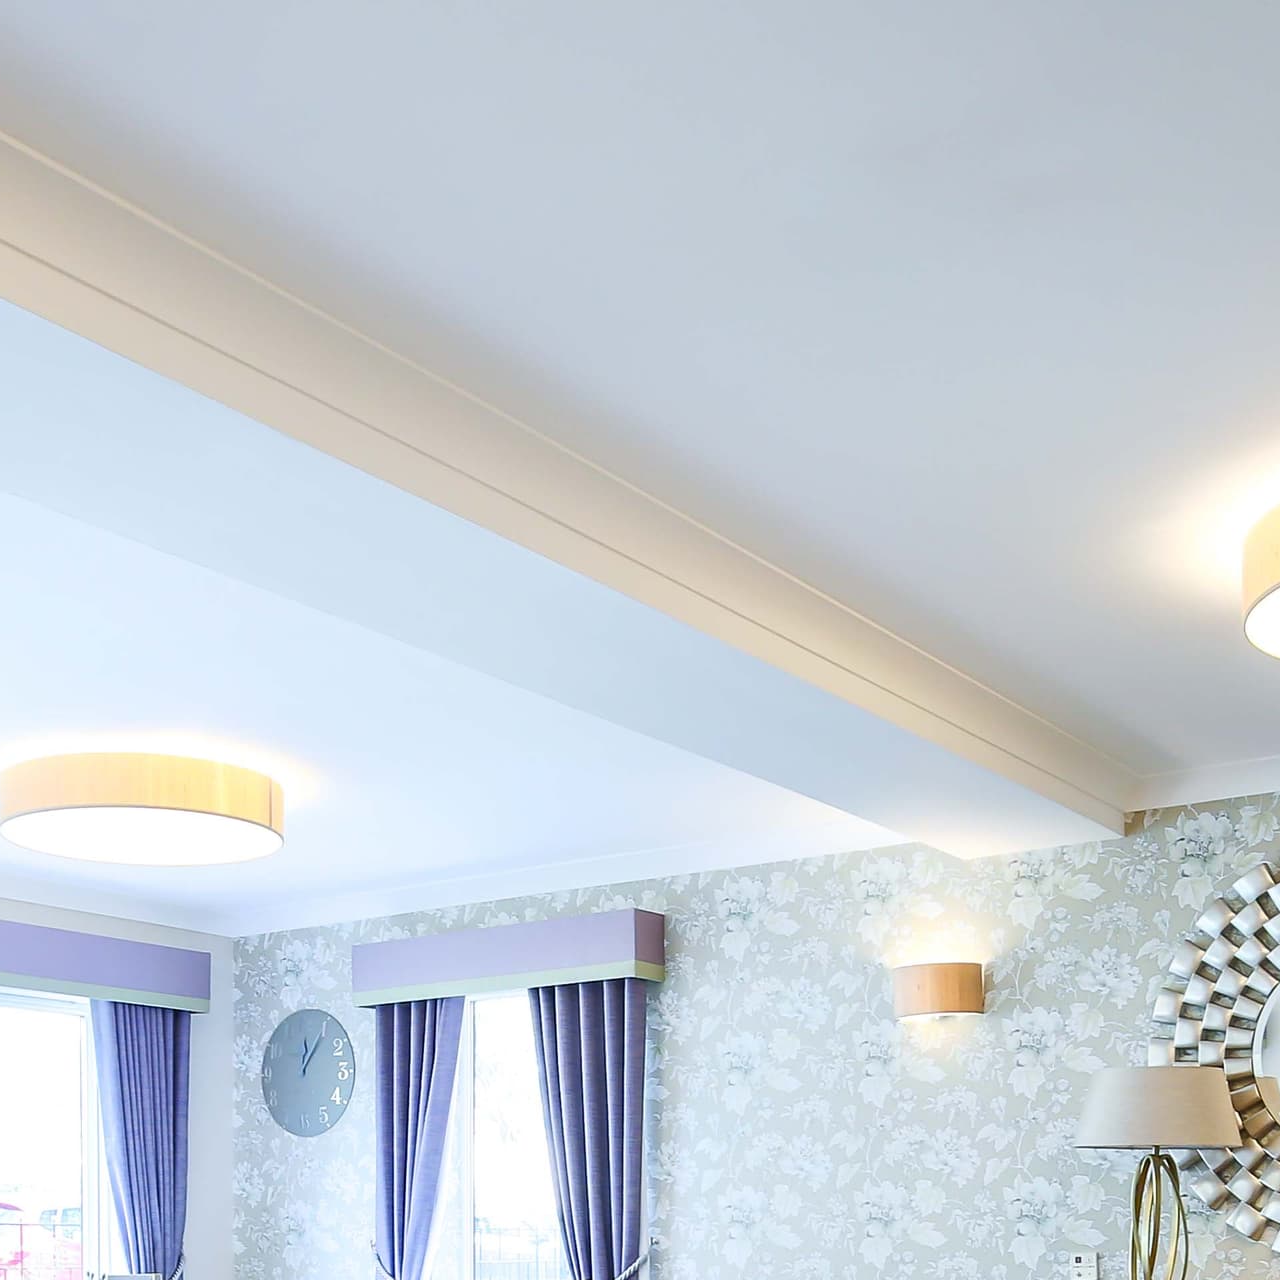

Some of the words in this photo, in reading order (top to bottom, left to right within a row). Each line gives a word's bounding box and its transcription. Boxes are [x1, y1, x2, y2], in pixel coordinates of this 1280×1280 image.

[333, 1038, 344, 1057] 2
[338, 1062, 350, 1081] 3
[330, 1086, 343, 1105] 4
[319, 1106, 329, 1124] 5
